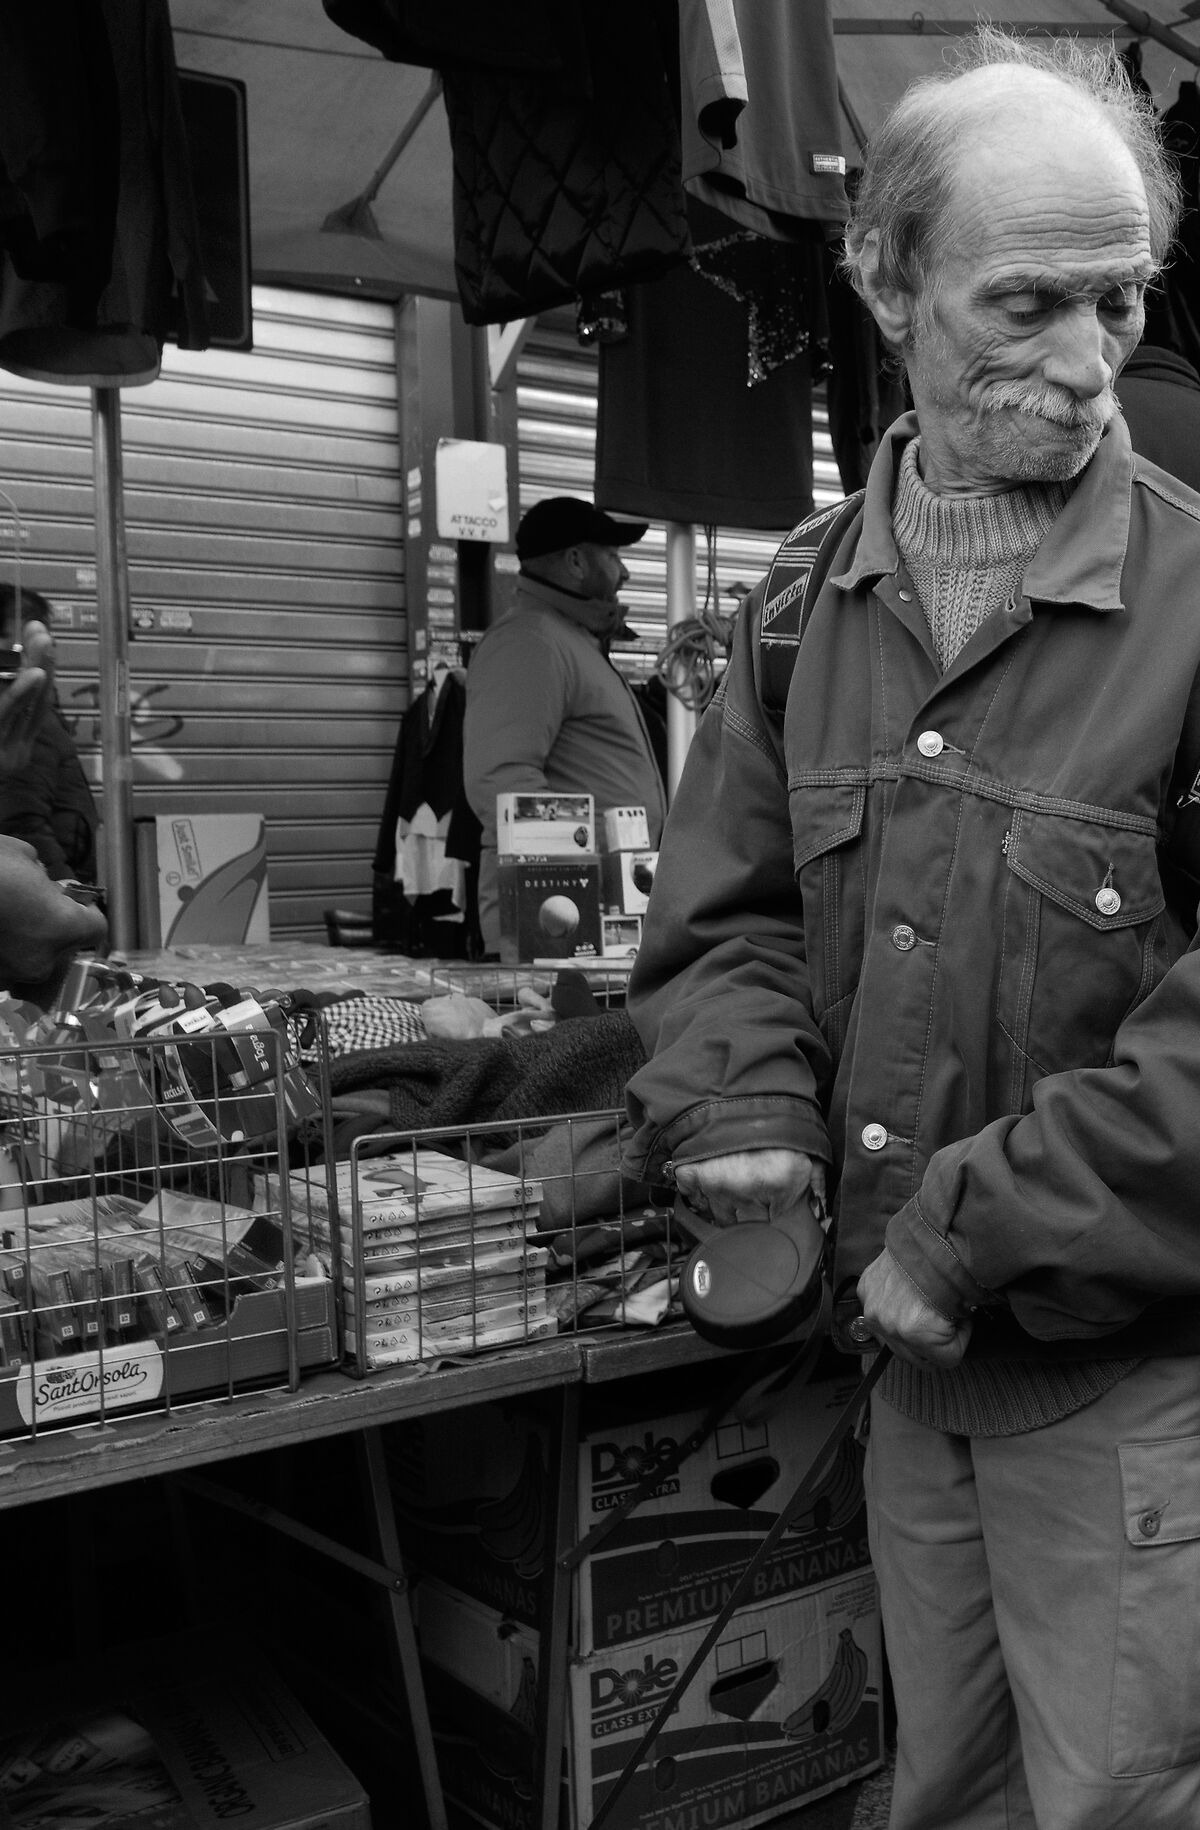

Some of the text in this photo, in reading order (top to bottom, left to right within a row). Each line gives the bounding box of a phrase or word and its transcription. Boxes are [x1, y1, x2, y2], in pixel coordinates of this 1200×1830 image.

[451, 514, 498, 528] ATTACCO
[764, 583, 804, 623] invicta
[525, 879, 578, 888] DESTINY
[591, 1432, 678, 1483] Dole
[753, 1537, 870, 1597] BANANAS
[591, 1654, 678, 1706] Dole
[594, 1715, 635, 1737] CLASS
[755, 1737, 870, 1806] BANANAS
